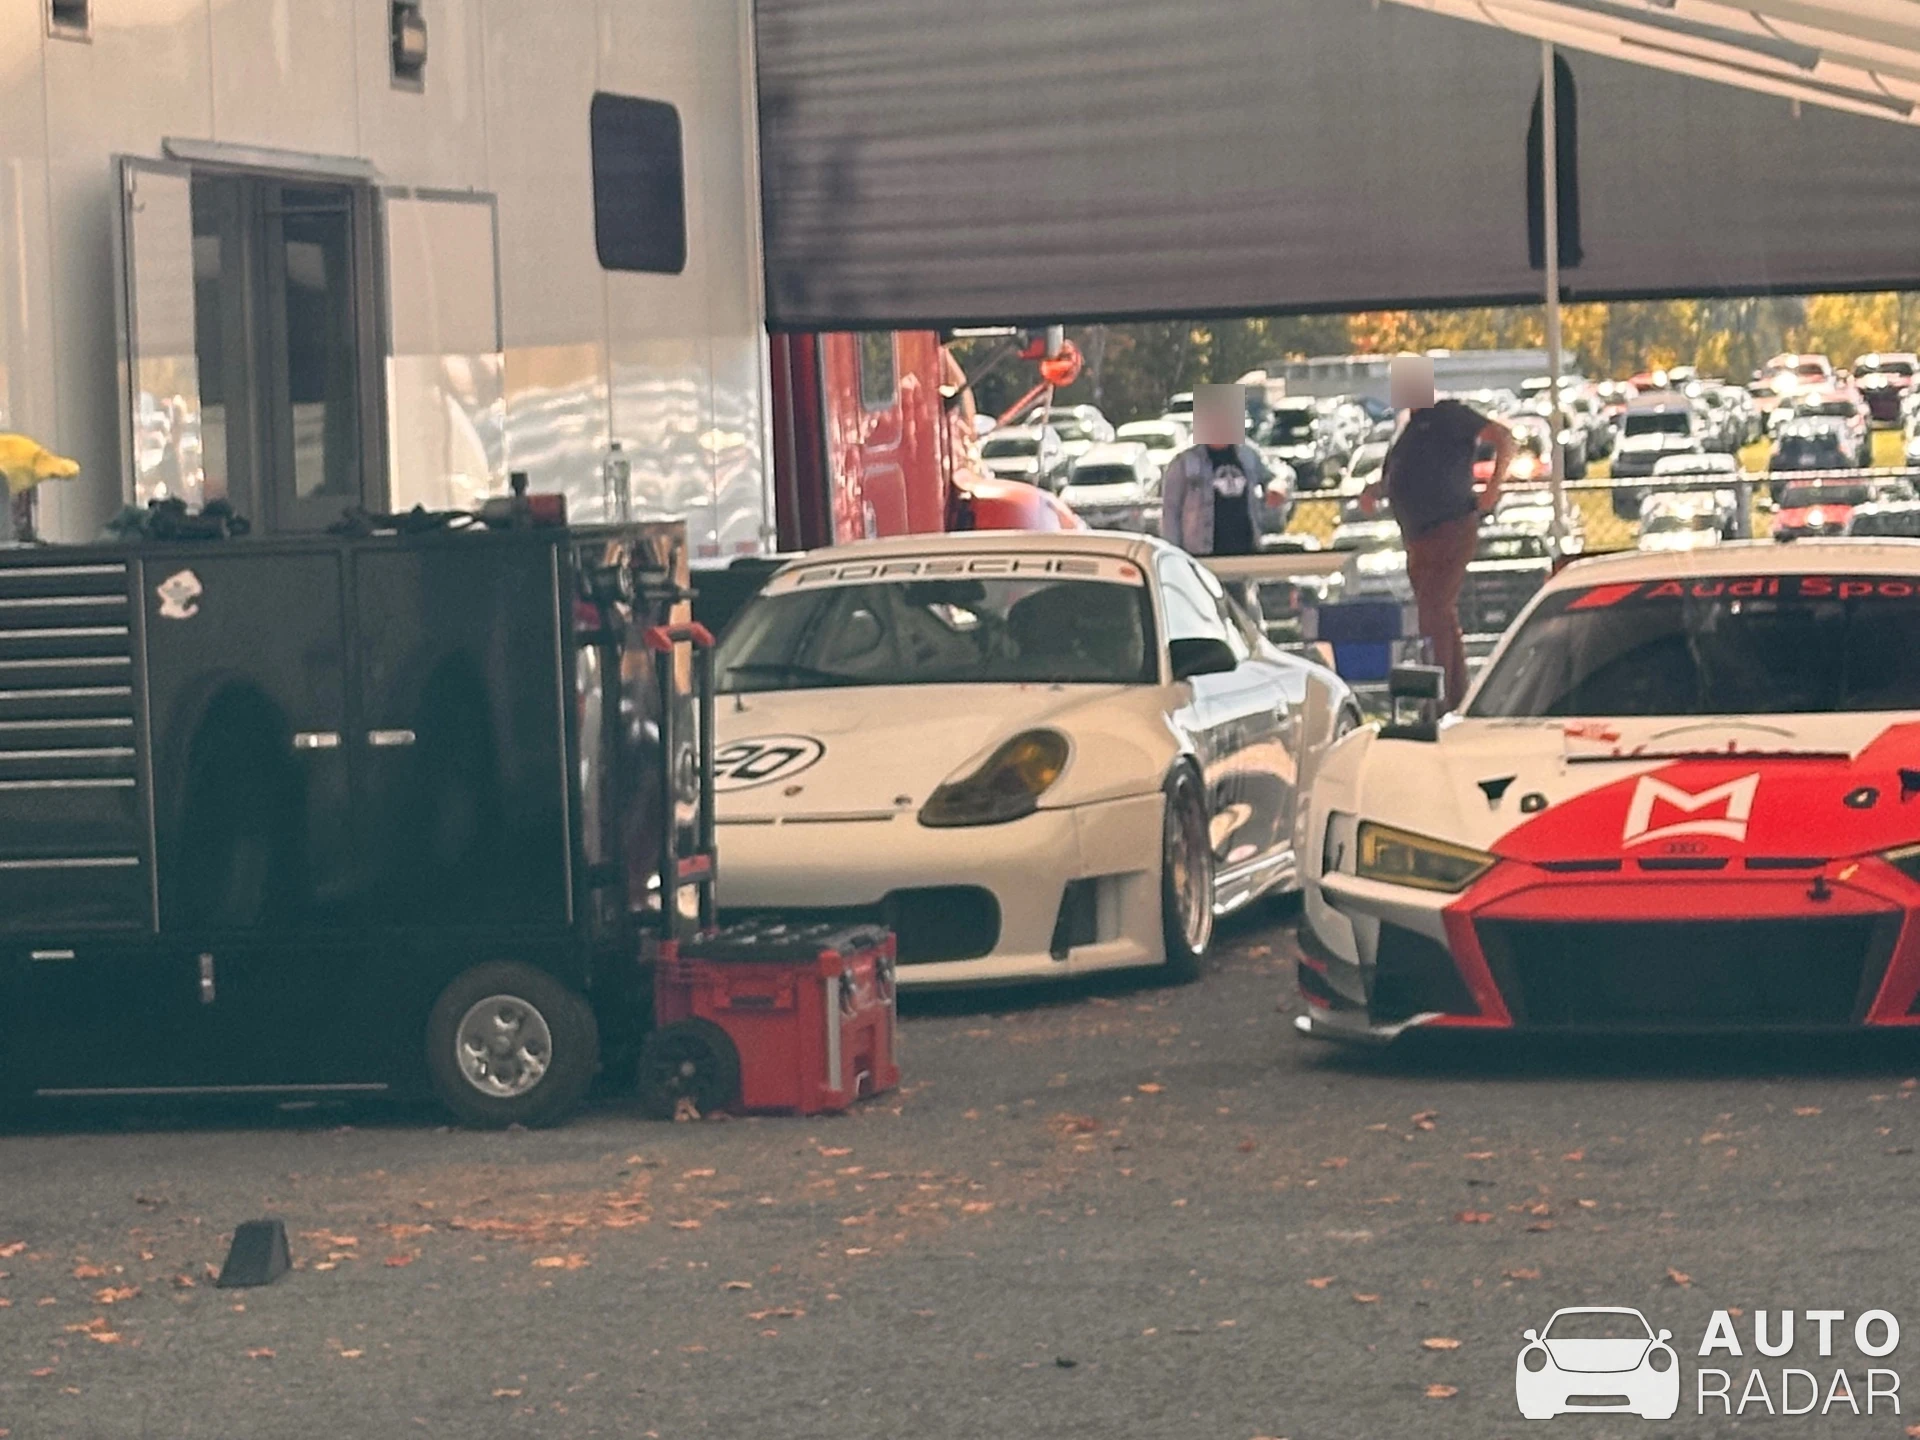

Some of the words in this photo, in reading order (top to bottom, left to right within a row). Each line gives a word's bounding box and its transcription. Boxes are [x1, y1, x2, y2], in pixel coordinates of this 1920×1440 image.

[797, 558, 1099, 585] PORSCHE
[1644, 577, 1779, 598] Audi
[1799, 575, 1920, 599] Spo
